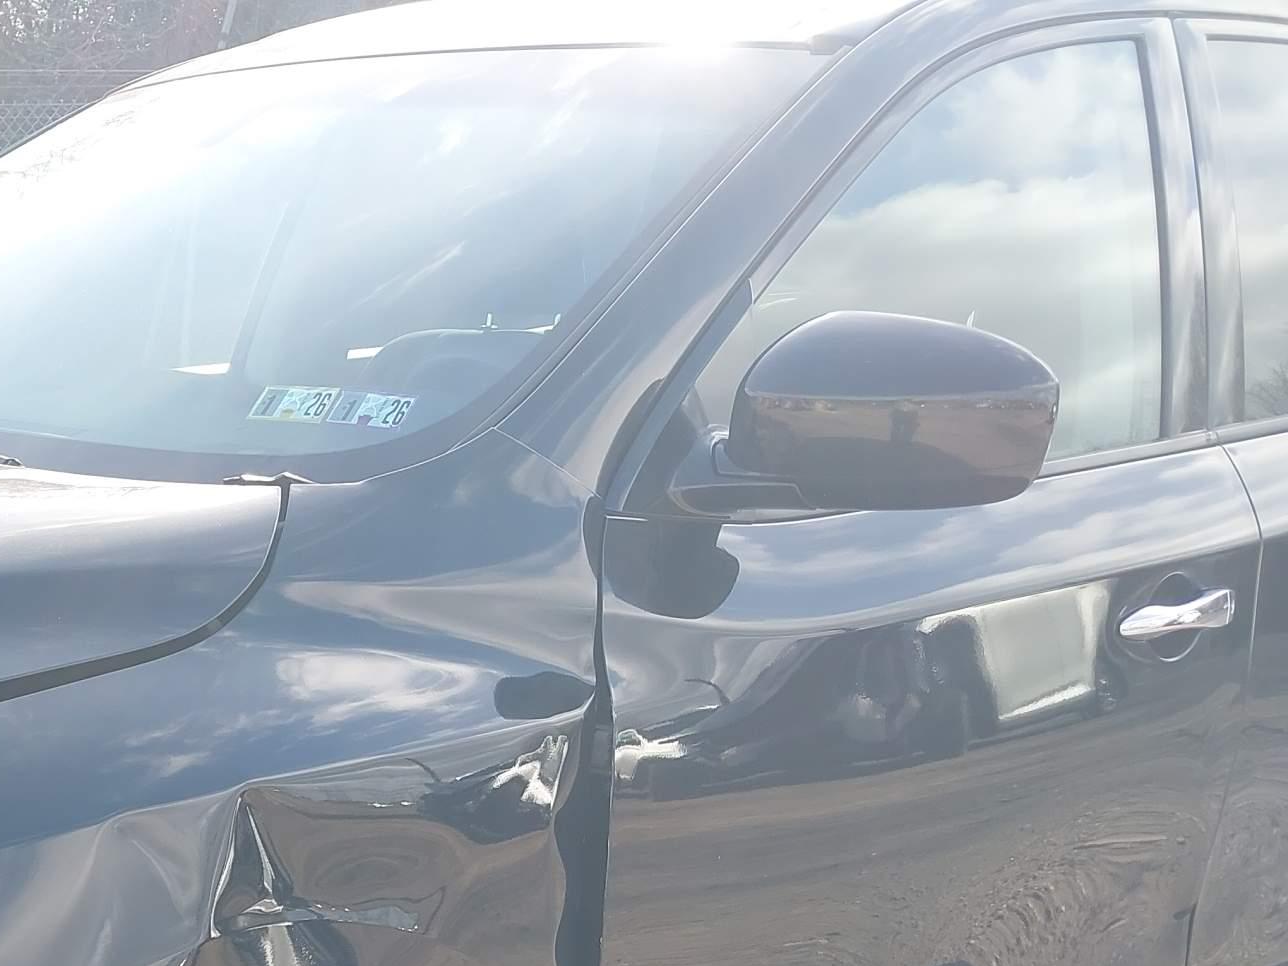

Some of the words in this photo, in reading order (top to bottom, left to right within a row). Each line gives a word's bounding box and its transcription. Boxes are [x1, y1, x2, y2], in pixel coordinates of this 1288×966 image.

[260, 394, 277, 416] 1
[303, 392, 333, 417] 26
[341, 399, 357, 421] 1
[381, 399, 412, 426] 26
